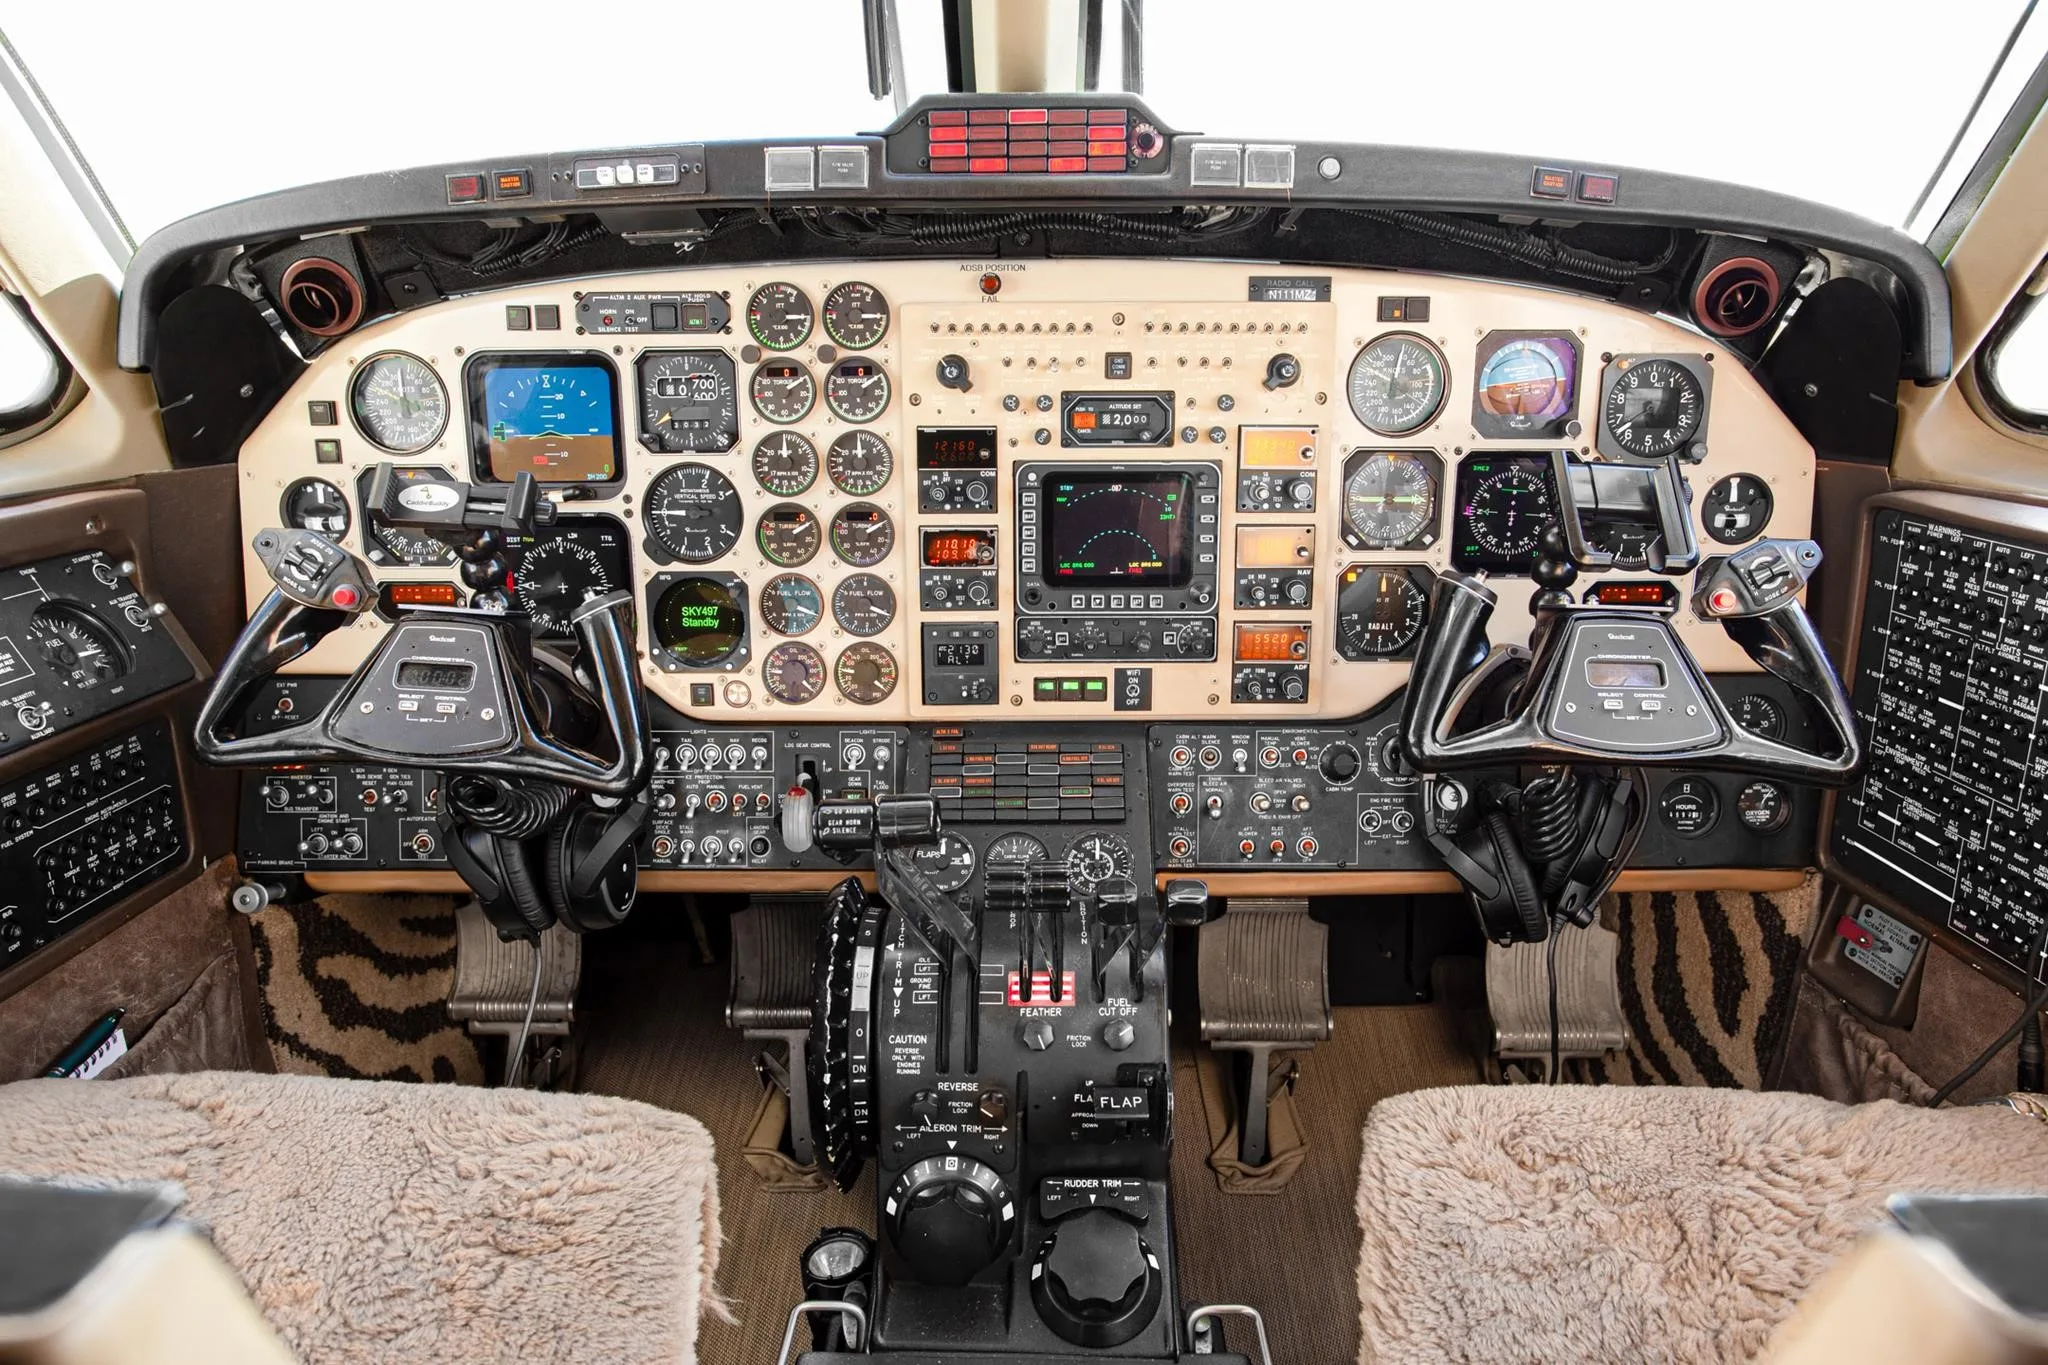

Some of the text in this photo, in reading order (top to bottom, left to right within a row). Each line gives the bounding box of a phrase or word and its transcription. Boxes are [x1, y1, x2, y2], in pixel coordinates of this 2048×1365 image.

[1269, 290, 1313, 300] N111MZ
[1651, 373, 1657, 382] 0
[1670, 378, 1674, 386] 1
[1631, 378, 1637, 387] 9
[1618, 394, 1624, 403] 8
[1616, 414, 1623, 423] 7
[1679, 416, 1685, 425] 3
[1038, 431, 1049, 442] DIM
[1625, 430, 1632, 439] 6
[1664, 430, 1670, 439] 4
[1645, 435, 1652, 445] 5
[718, 491, 724, 500] 3
[1928, 524, 1961, 536] WARNINGS
[1927, 531, 1943, 539] POWER
[705, 537, 710, 545] 2
[1951, 536, 1963, 544] LEFT
[1974, 541, 1987, 549] LEFT
[2021, 552, 2035, 560] LEFT
[1985, 581, 2009, 592] FEATHER
[2011, 591, 2029, 600] START
[1987, 597, 2004, 606] STALL
[682, 607, 718, 616] SKY497
[682, 618, 719, 628] Standby
[1918, 617, 1939, 629] FLIGHT
[1932, 630, 1951, 640] COPILOT
[1982, 630, 1996, 639] WARN
[45, 638, 64, 648] FUEL
[2004, 637, 2020, 646] RIGHT
[1996, 643, 2021, 656] LIGHTS
[1998, 651, 2020, 662] AVIONICS
[1950, 670, 1965, 679] ALERT
[2014, 709, 2036, 722] READING
[1960, 725, 1981, 738] CONSOLE
[1885, 746, 1931, 773] ENVIRONMENTAL
[2003, 758, 2025, 770] AVIONICS
[1953, 785, 1967, 795] CABIN
[1976, 782, 1993, 794] LIGHTS
[86, 798, 99, 807] RIGHT
[1902, 802, 1936, 823] FURNISHING
[15, 830, 34, 842] SYSTEM
[1990, 854, 2002, 864] LEFT
[64, 866, 80, 878] TORQUE
[2008, 864, 2030, 879] CONTROL
[856, 972, 869, 980] UP
[1108, 998, 1131, 1007] FUEL
[1020, 1008, 1061, 1017] FEATHER
[1099, 1008, 1138, 1016] CUT OFF
[889, 1035, 927, 1044] CAUTION
[853, 1064, 866, 1073] DN
[938, 1082, 978, 1091] REVERSE
[1100, 1096, 1142, 1108] FLAP
[854, 1108, 868, 1116] DN
[920, 1123, 981, 1133] AILERON TRIM
[1064, 1179, 1122, 1188] RUDDER TRIM
